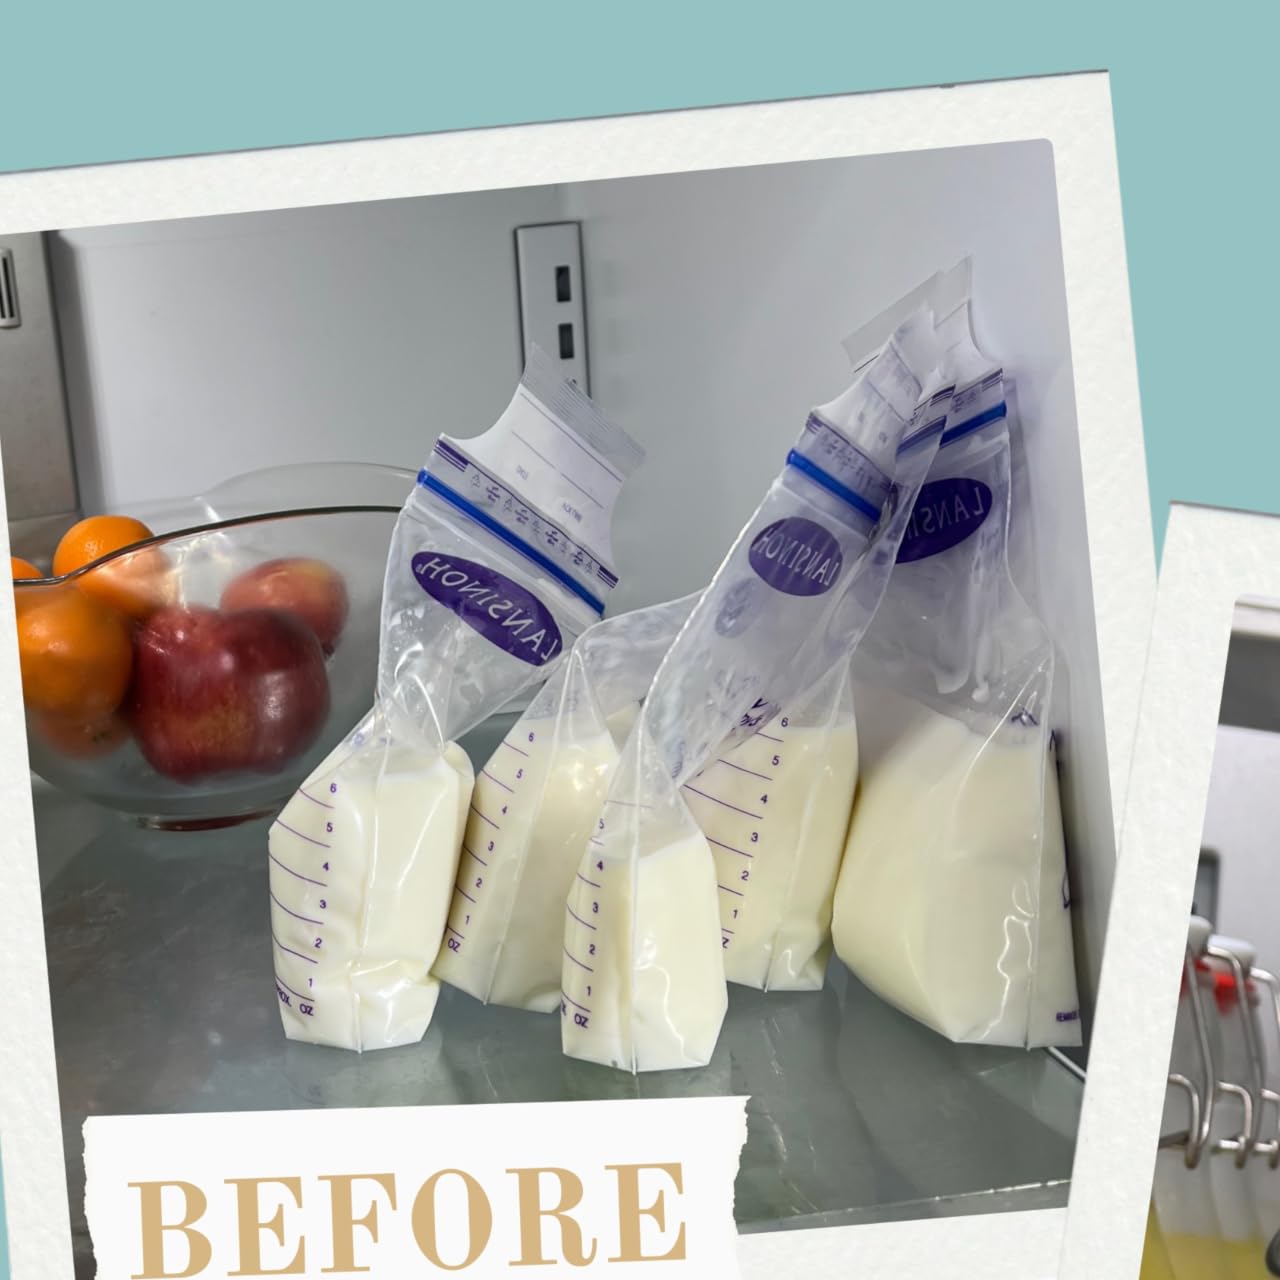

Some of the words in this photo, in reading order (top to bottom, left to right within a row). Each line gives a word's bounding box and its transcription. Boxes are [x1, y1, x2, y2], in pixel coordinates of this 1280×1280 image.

[780, 716, 789, 728] 6
[528, 732, 535, 743] 6
[771, 755, 780, 766] 5
[516, 768, 524, 779] 5
[329, 782, 337, 794] 6
[760, 793, 768, 805] 4
[501, 805, 508, 816] 4
[326, 821, 334, 833] 5
[750, 831, 759, 843] 3
[487, 840, 495, 852] 3
[322, 861, 330, 873] 4
[596, 859, 604, 872] 4
[740, 870, 750, 881] 2
[475, 877, 483, 889] 2
[319, 899, 327, 909] 3
[592, 901, 599, 914] 3
[314, 937, 323, 949] 2
[447, 937, 462, 953] OZ
[588, 943, 596, 956] 2
[299, 1003, 314, 1017] OZ
[574, 1012, 589, 1029] OZ
